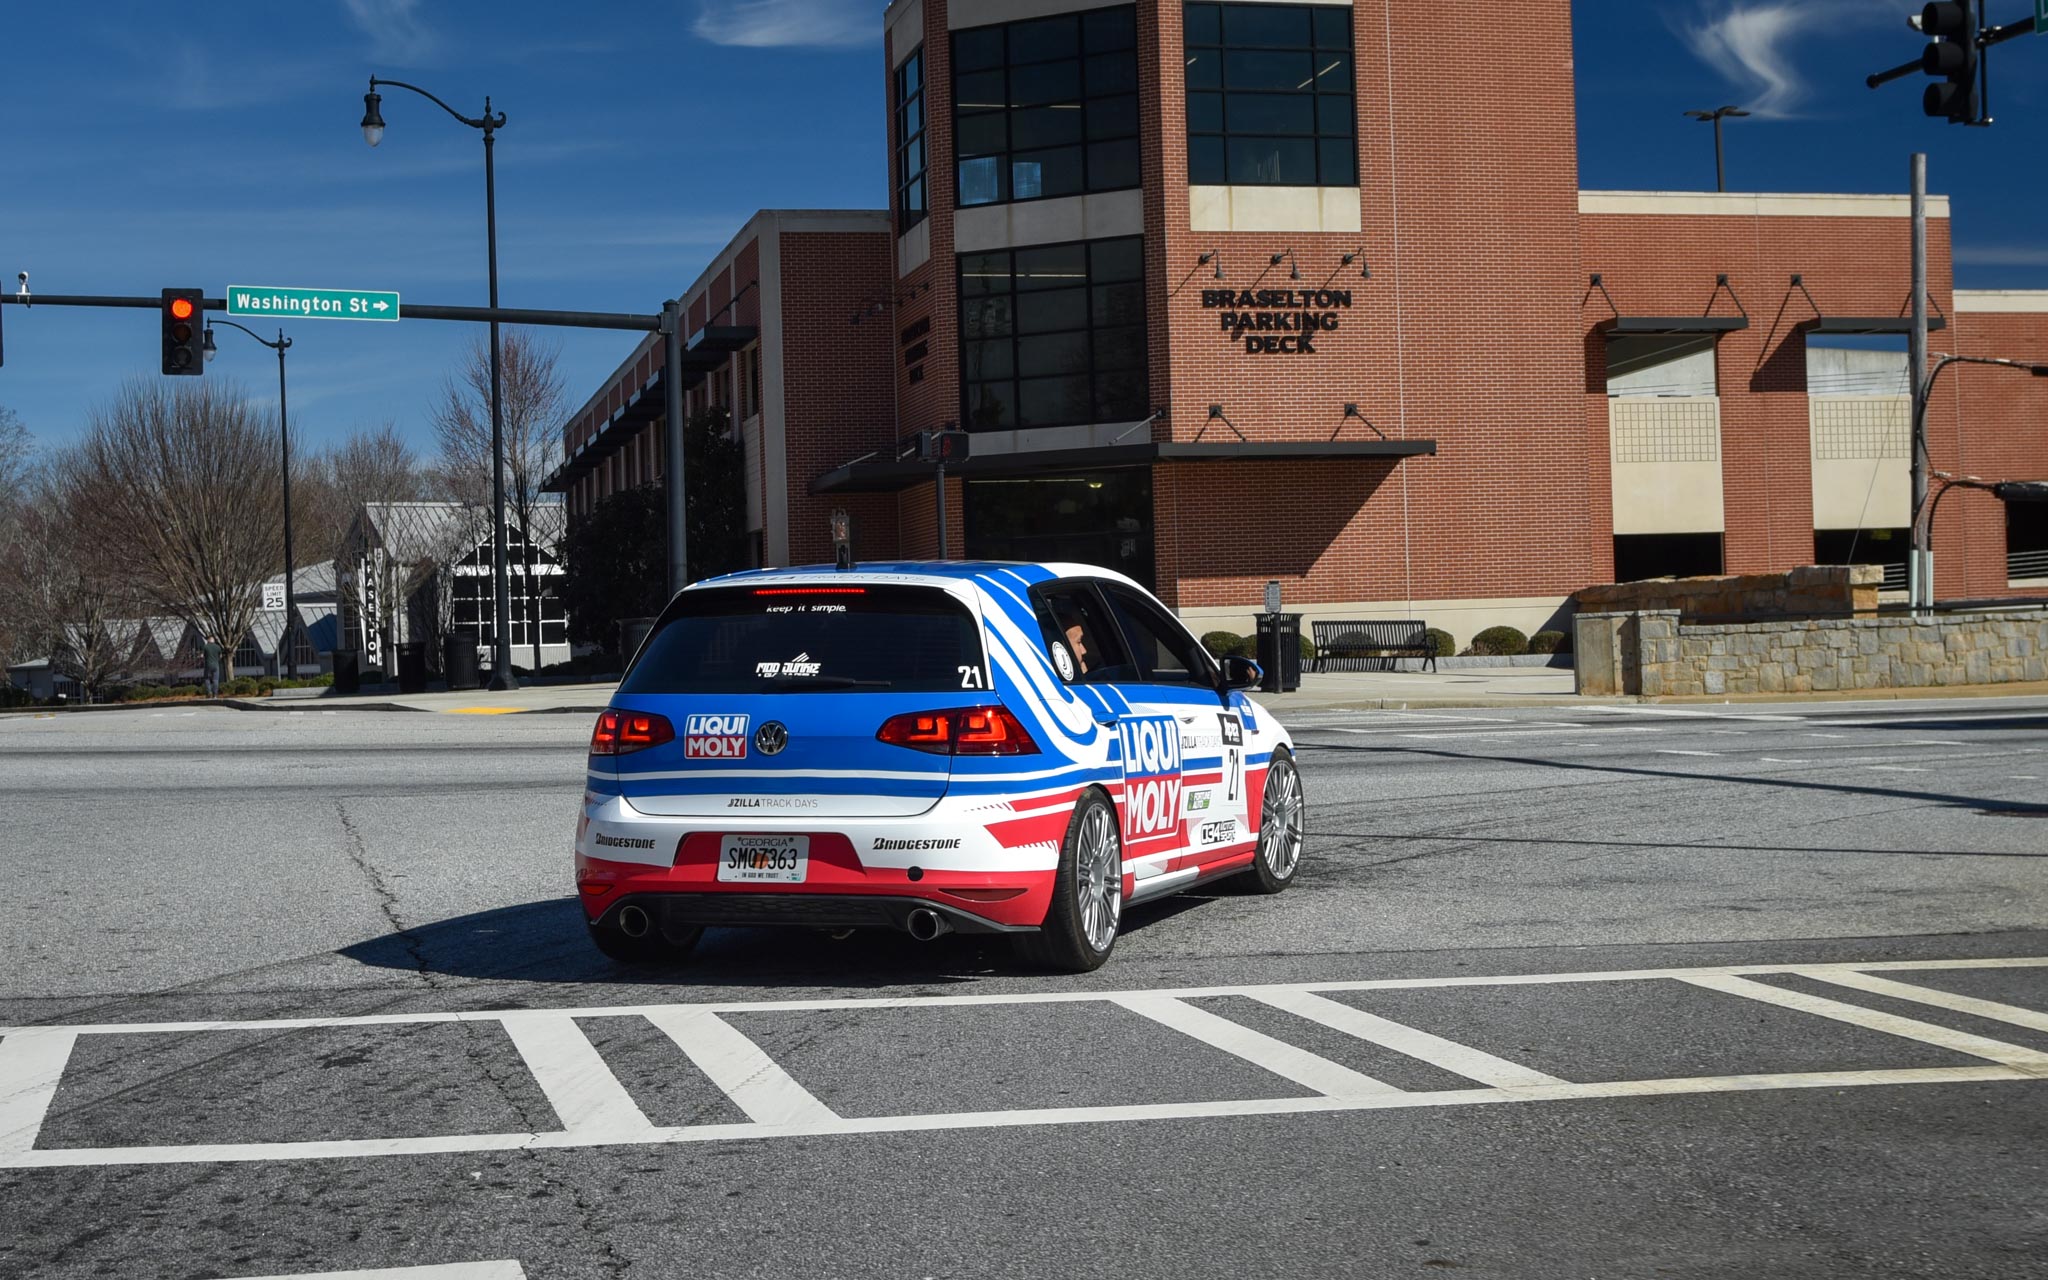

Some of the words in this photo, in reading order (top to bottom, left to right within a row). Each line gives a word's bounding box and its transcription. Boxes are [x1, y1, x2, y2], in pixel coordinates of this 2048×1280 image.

[237, 293, 342, 315] Washington
[350, 298, 368, 313] St
[1202, 290, 1352, 308] BRASELTON
[1221, 313, 1338, 331] PARKING
[1246, 336, 1316, 354] DECK
[266, 597, 284, 608] 25
[766, 604, 793, 614] keep
[798, 604, 806, 612] it
[957, 665, 983, 689] 21
[688, 716, 746, 735] LIQUI
[688, 737, 745, 756] MOLY
[1120, 720, 1180, 774] LIQUI
[1228, 748, 1239, 800] 21
[795, 799, 818, 808] DAYS
[1127, 779, 1181, 836] MOLY
[595, 832, 656, 849] BRIDGESTONE
[740, 837, 789, 847] GEORGIA
[872, 837, 962, 850] BRIDGESTONE
[727, 847, 798, 870] SMQ7363
